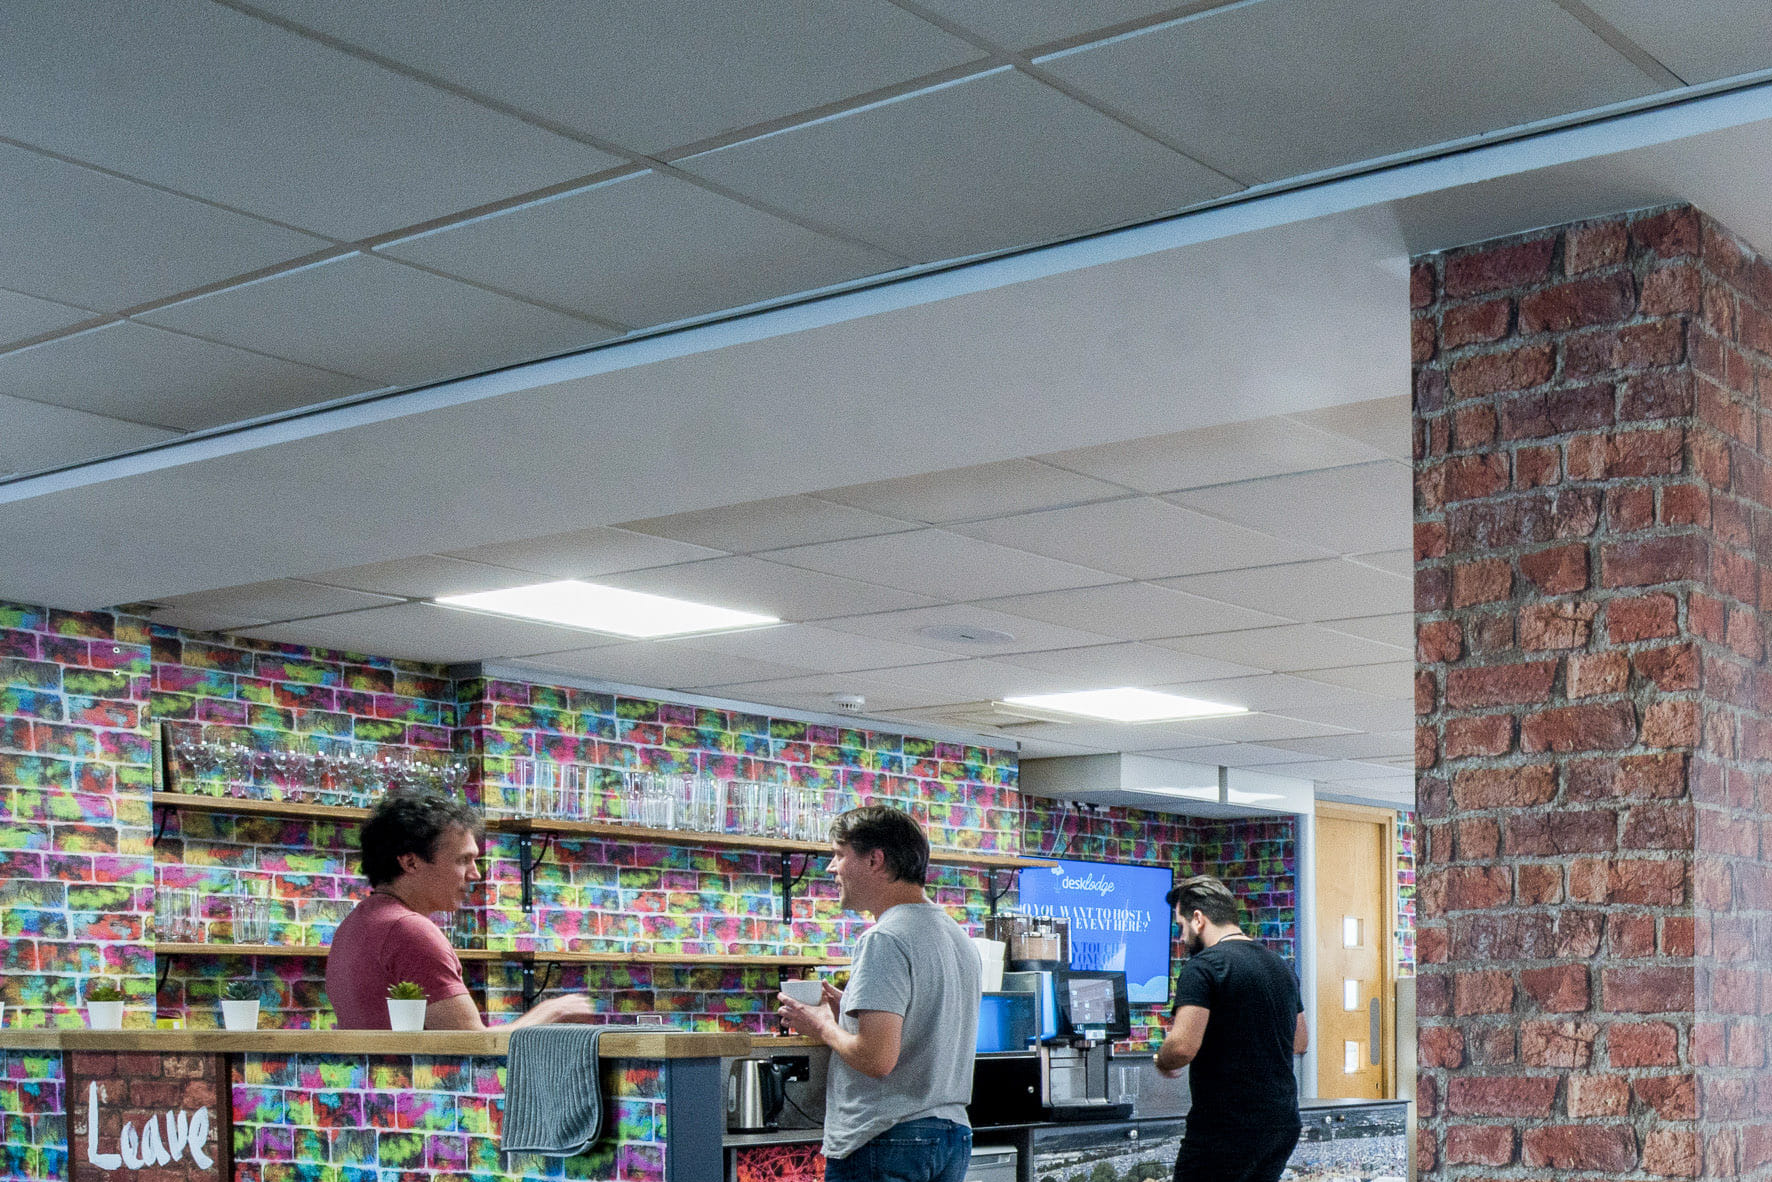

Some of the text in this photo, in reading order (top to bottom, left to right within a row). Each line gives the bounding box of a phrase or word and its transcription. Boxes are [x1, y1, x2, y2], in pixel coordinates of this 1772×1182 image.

[1062, 873, 1115, 896] desklodge
[1096, 907, 1111, 920] TO
[1113, 908, 1142, 921] HOST
[1075, 917, 1148, 933] EVENT HERE?
[88, 1080, 213, 1170] Leave
